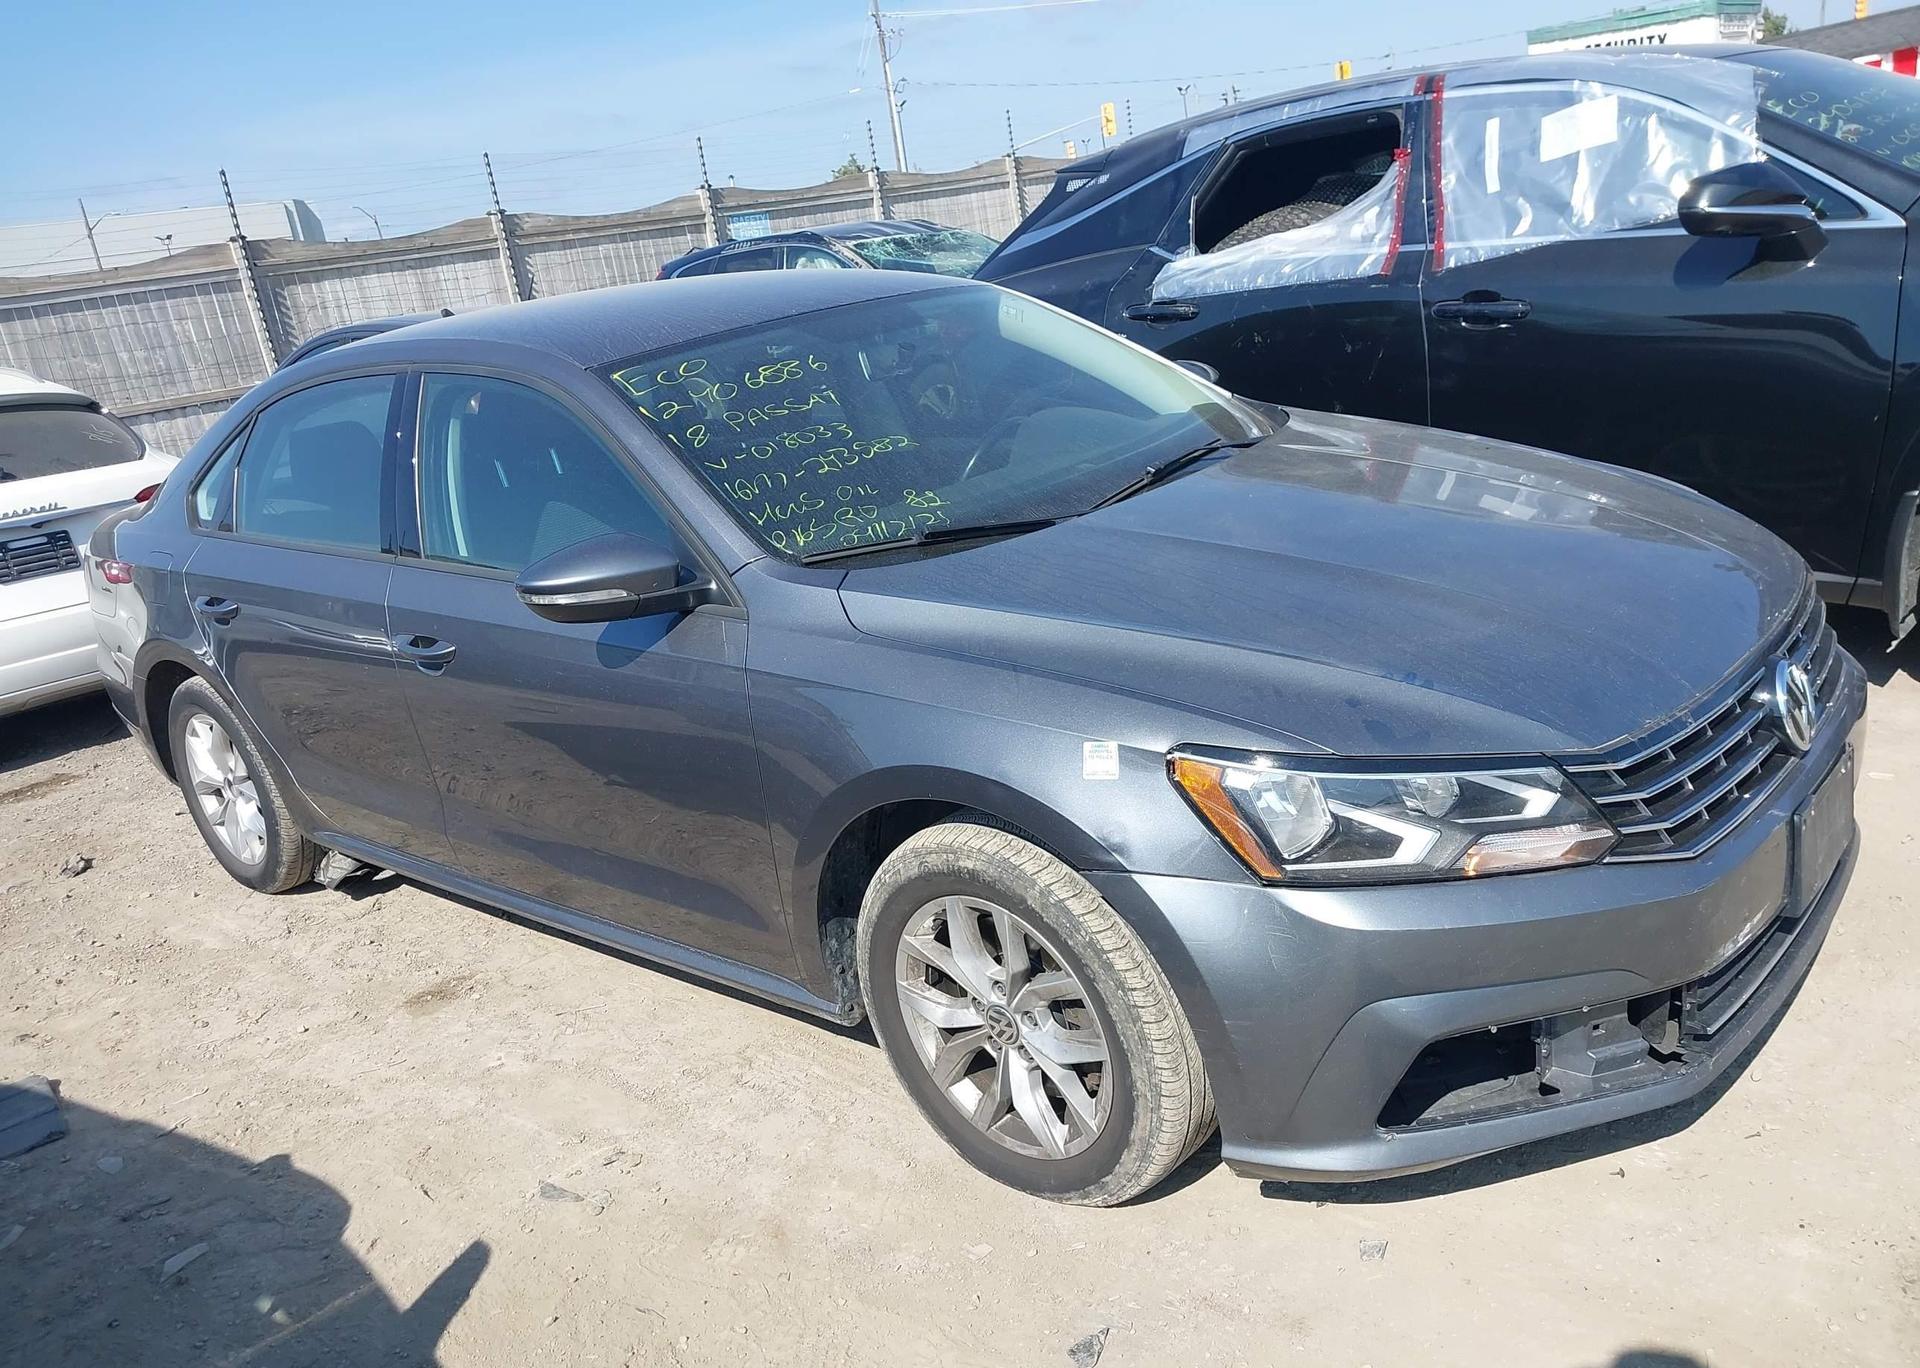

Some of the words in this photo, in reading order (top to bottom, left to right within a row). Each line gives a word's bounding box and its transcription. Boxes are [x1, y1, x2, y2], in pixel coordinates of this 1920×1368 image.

[610, 359, 707, 396] ECO
[667, 424, 710, 448] 18
[723, 389, 841, 432] PASSAT
